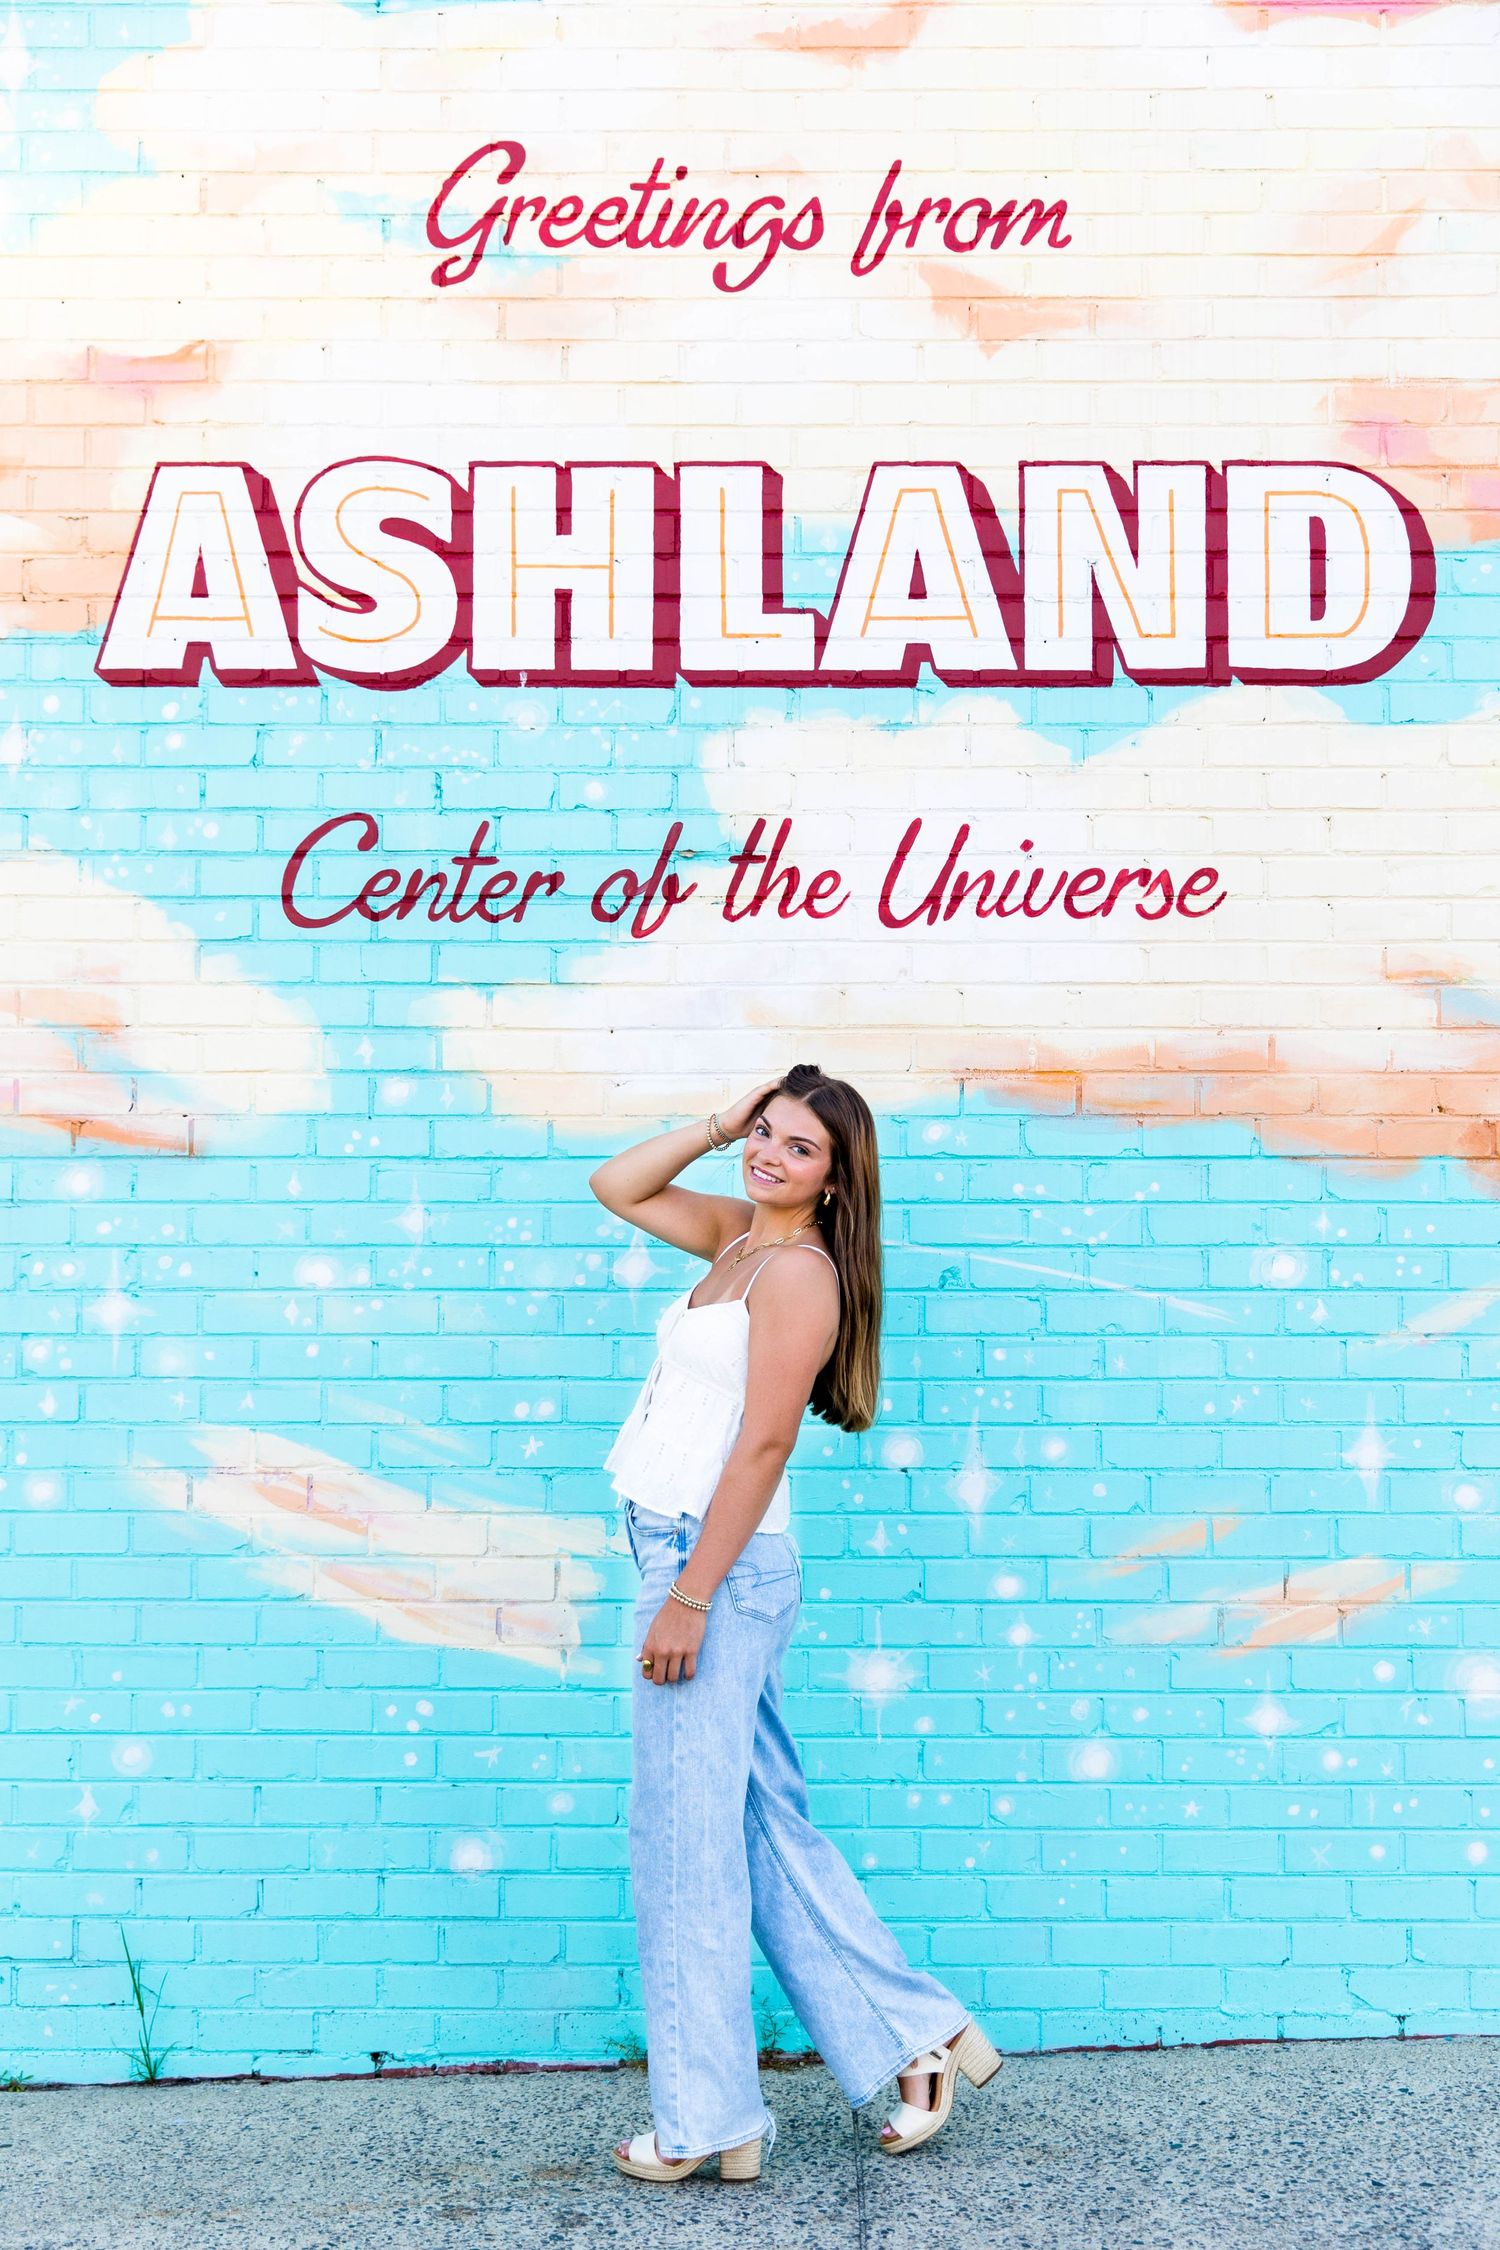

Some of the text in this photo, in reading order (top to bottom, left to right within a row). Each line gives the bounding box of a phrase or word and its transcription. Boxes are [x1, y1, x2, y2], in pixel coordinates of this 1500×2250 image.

[427, 140, 1072, 292] Greetings from
[96, 456, 1435, 690] ASHLAND
[281, 812, 1227, 939] Center of the Universe
